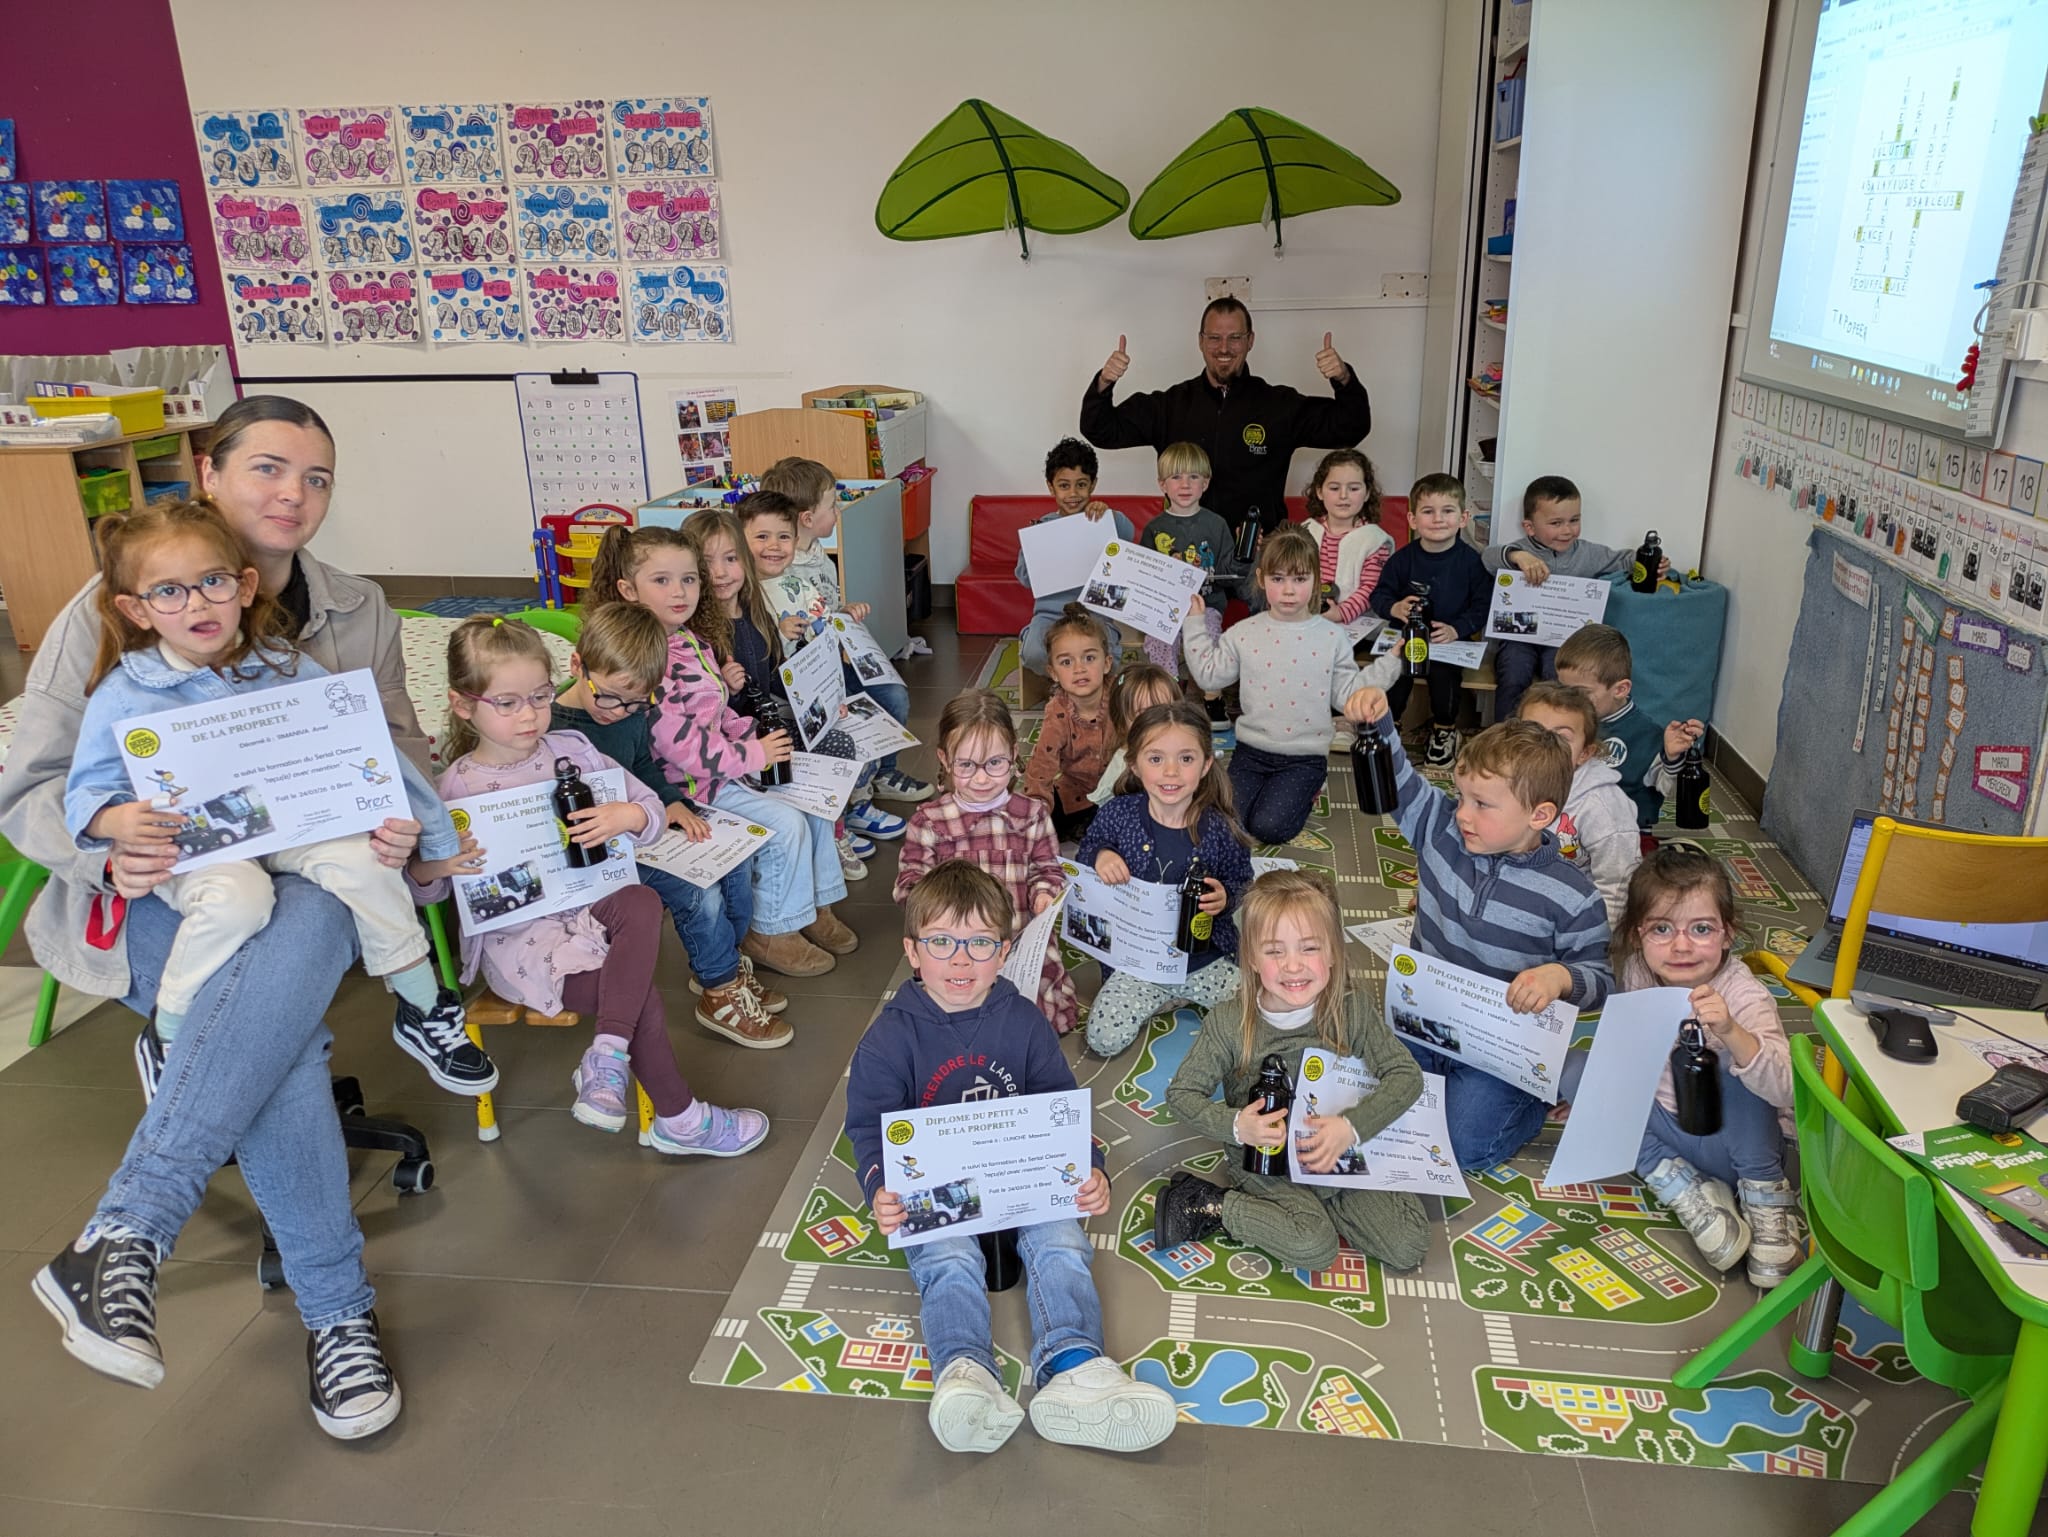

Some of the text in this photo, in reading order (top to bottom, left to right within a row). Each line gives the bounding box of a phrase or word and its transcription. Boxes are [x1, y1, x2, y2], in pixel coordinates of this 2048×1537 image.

[527, 397, 628, 411] A B C D E F
[533, 429, 541, 437] G
[549, 427, 556, 436] H
[587, 428, 593, 436] J
[605, 428, 612, 436] K
[624, 428, 630, 436] L
[1747, 394, 1753, 410] 2
[1759, 397, 1764, 414] 3
[1784, 405, 1790, 423] 5
[1796, 409, 1802, 427] 6
[1810, 413, 1818, 431] 7
[1826, 417, 1832, 436] 8
[1839, 422, 1847, 441] 9
[1854, 427, 1864, 447] 10
[1870, 432, 1880, 454] 11
[1887, 438, 1898, 460] 12
[1905, 442, 1917, 465] 13
[1925, 448, 1937, 472] 14
[1946, 453, 1960, 478] 15
[1969, 460, 1981, 485] 16
[1993, 468, 2008, 492] 17
[2019, 474, 2035, 501] 18
[536, 455, 637, 463] M N O P Q R
[543, 482, 635, 491] S T U V W X
[170, 697, 301, 733] DIPLOME DU PETIT AS
[191, 714, 290, 744] DE LA PROPRETE
[266, 757, 302, 772] formation
[315, 750, 334, 761] Serial
[335, 745, 362, 757] Cleaner
[355, 794, 393, 812] Brest
[479, 797, 521, 814] DIPLOME
[522, 794, 534, 804] DU
[493, 814, 506, 823] DE
[507, 811, 519, 821] LA
[602, 867, 627, 881] Brest
[1156, 961, 1178, 974] Brest
[1427, 964, 1466, 985] DIPLOME
[1467, 980, 1479, 990] DU
[1480, 984, 1505, 999] PETIT
[1435, 978, 1504, 1009] DE LA PROPRETE
[920, 1053, 1020, 1108] PRENDRE LE LARGE
[1337, 1076, 1356, 1087] DE LA
[1519, 1075, 1547, 1094] Brest
[925, 1107, 1029, 1127] DIPLOME DU PETIT AS
[938, 1120, 1017, 1137] DE LA PROPRETE
[988, 1158, 1018, 1168] formation
[1028, 1154, 1045, 1163] Serial
[1930, 1150, 1993, 1170] Propik
[1991, 1150, 2048, 1170] Beurk
[1426, 1169, 1454, 1183] Brest
